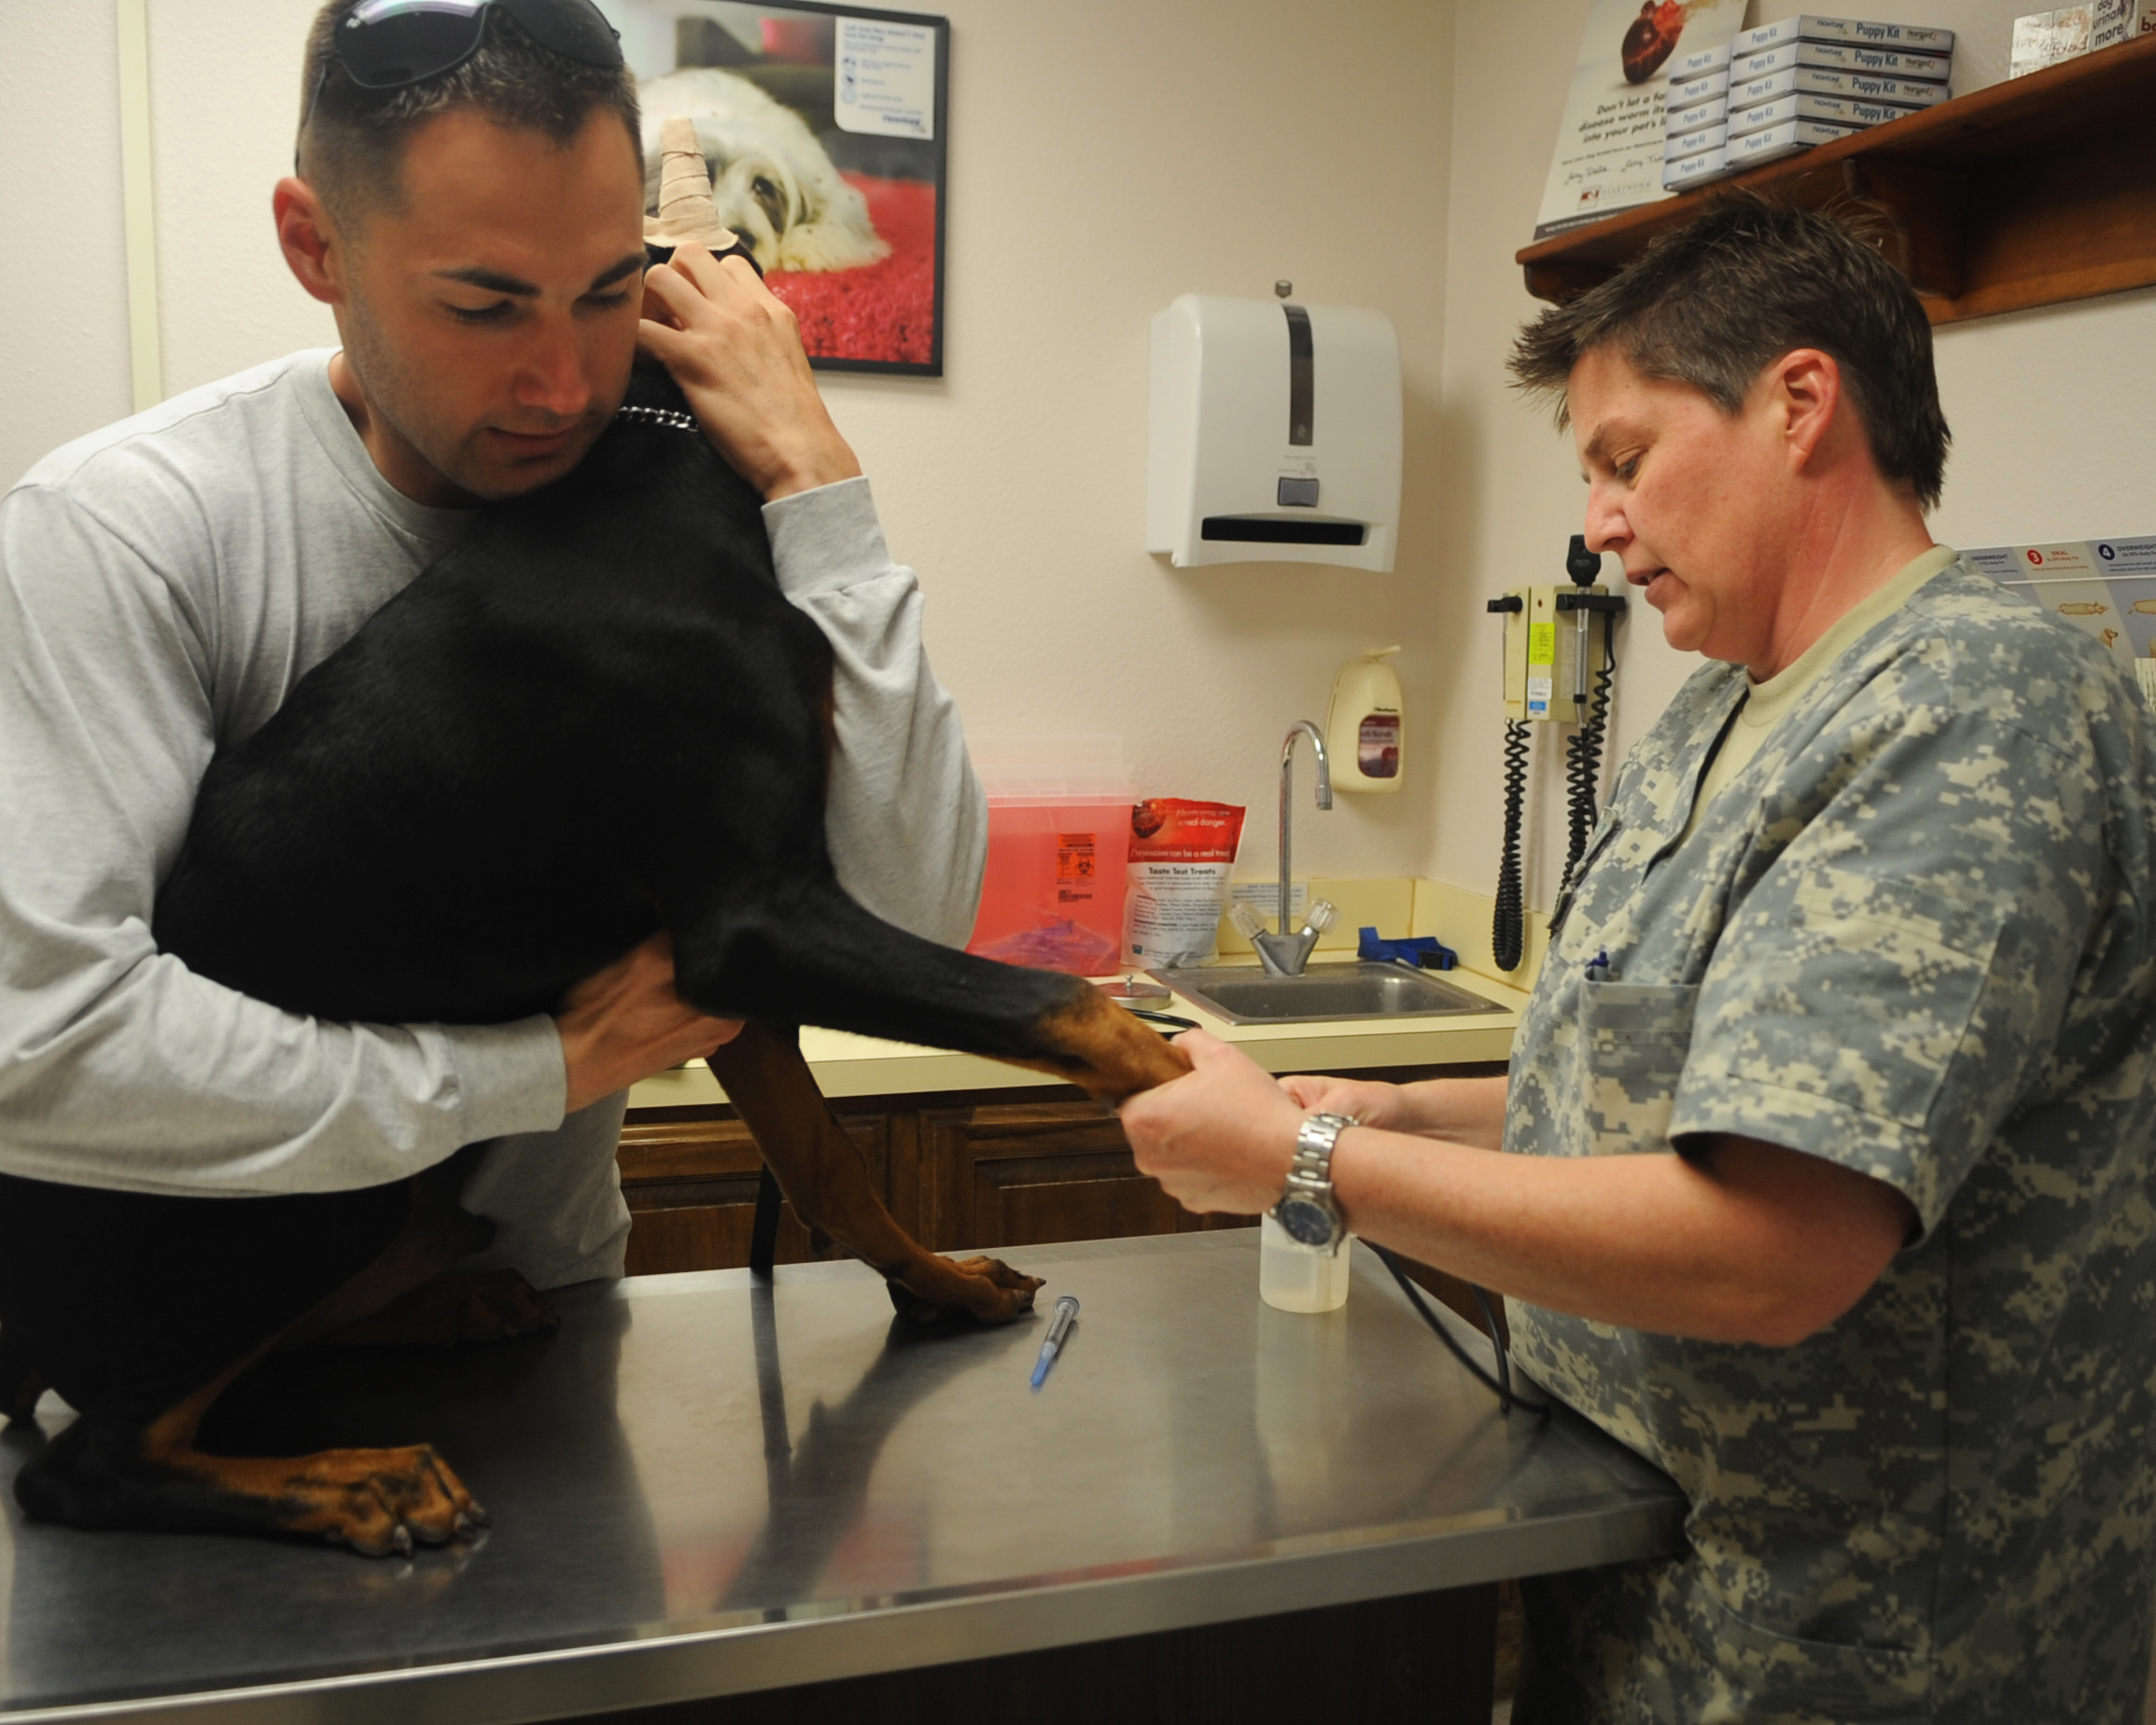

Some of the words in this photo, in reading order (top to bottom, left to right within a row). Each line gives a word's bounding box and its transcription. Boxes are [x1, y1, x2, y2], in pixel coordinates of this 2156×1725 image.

[1751, 31, 1768, 44] Puppy
[1856, 21, 1885, 39] Puppy
[1886, 25, 1900, 38] Kit
[2095, 23, 2123, 46] more
[1749, 59, 1766, 71] Puppy
[1767, 54, 1775, 64] Kit
[1855, 49, 1883, 67] Puppy
[1885, 53, 1898, 66] Kit
[1747, 84, 1764, 96] Puppy
[1765, 79, 1773, 90] Kit
[1852, 77, 1882, 93] Puppy
[1883, 80, 1897, 93] Kit
[1643, 95, 1650, 104] a
[1747, 111, 1764, 123] Puppy
[1765, 106, 1773, 118] Kit
[1853, 104, 1882, 120] Puppy
[1883, 107, 1896, 119] Kit
[1604, 126, 1629, 140] your
[1745, 137, 1762, 149] Puppy
[1764, 133, 1772, 143] Kit
[1183, 848, 1192, 858] be
